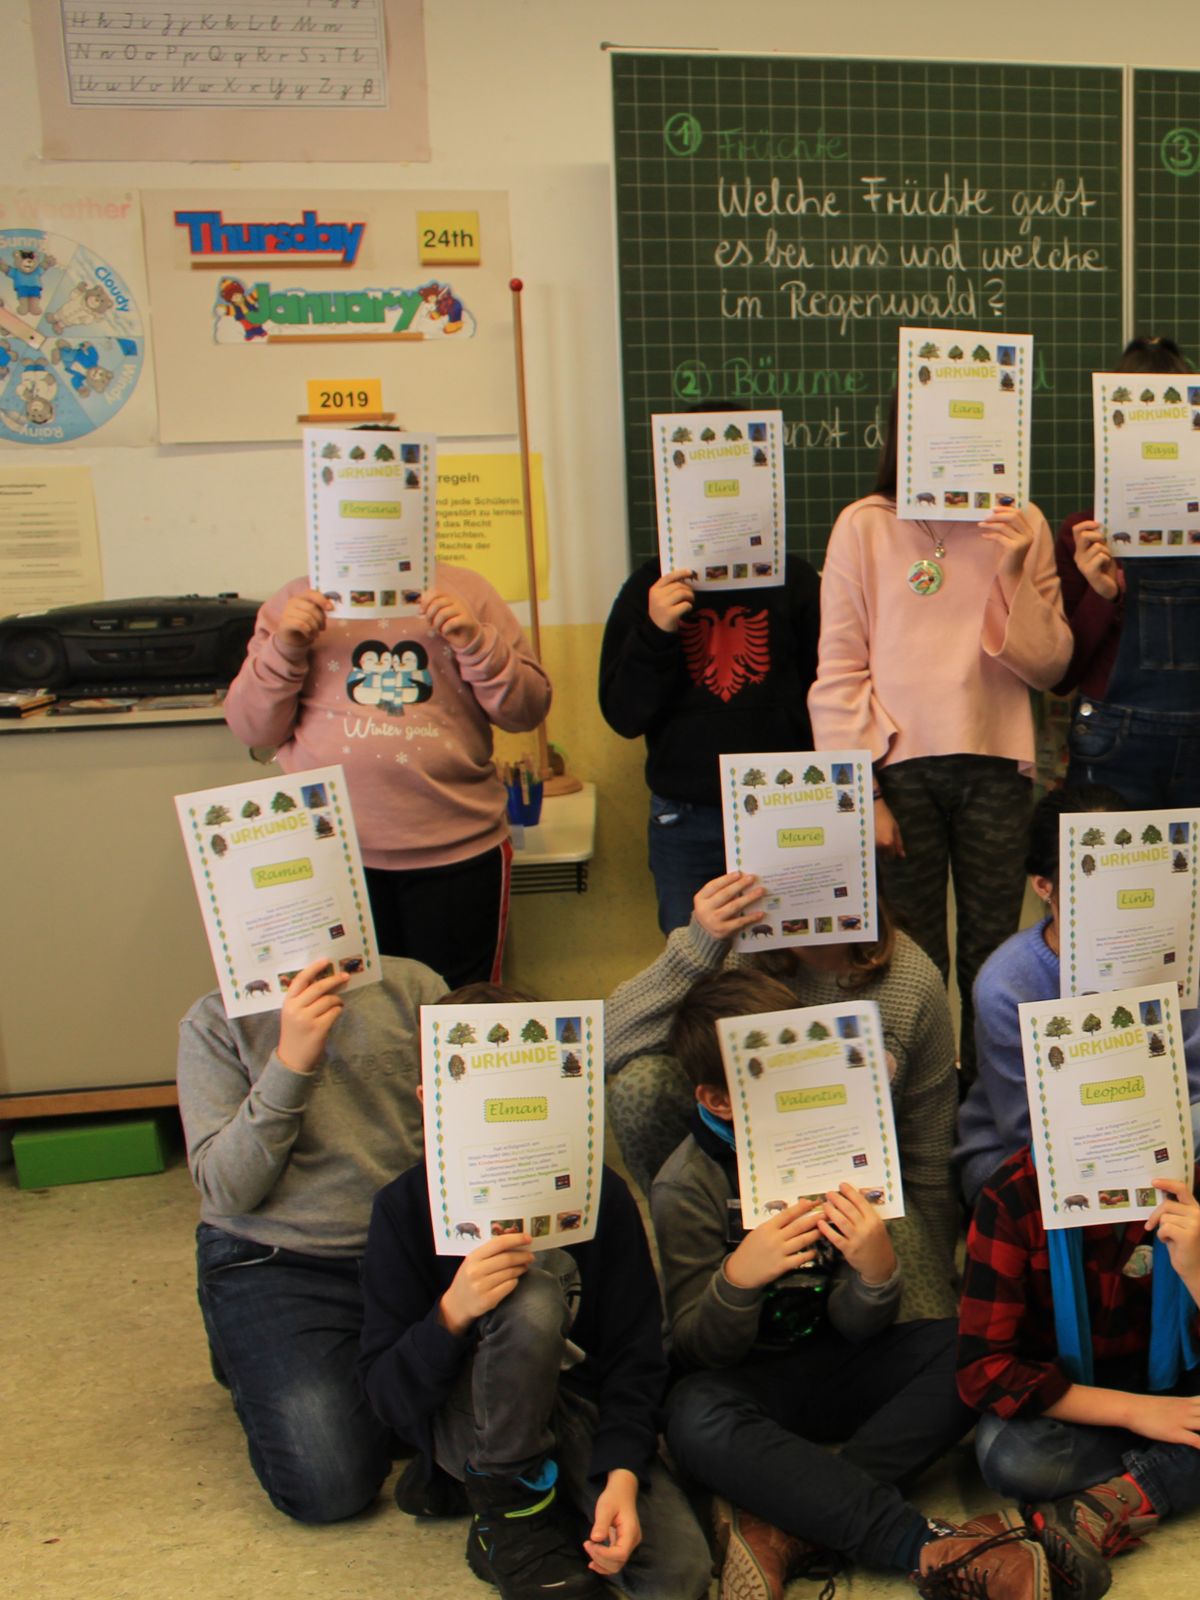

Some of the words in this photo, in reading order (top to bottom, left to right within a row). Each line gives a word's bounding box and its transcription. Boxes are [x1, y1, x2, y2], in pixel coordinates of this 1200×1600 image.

[719, 177, 842, 217] Welche
[861, 172, 995, 217] Früchte
[1011, 176, 1097, 234] gibt
[174, 210, 366, 264] Thursday
[423, 230, 474, 249] 24th
[715, 238, 753, 270] es
[762, 228, 814, 270] bei
[900, 229, 966, 270] und
[982, 236, 1108, 272] welche
[95, 266, 129, 312] Cloudy
[249, 283, 420, 333] January
[720, 288, 762, 319] im
[780, 280, 977, 335] Regenwald
[319, 390, 369, 409] 2019
[343, 717, 401, 738] Winter
[763, 787, 834, 806] URKUNDE
[231, 811, 309, 845] URKUNDE
[1100, 846, 1169, 867] URKUNDE
[1068, 1027, 1145, 1058] URKUNDE
[471, 1045, 557, 1069] URKUNDE
[1084, 1078, 1144, 1101] Leopold
[488, 1101, 545, 1118] Elman
